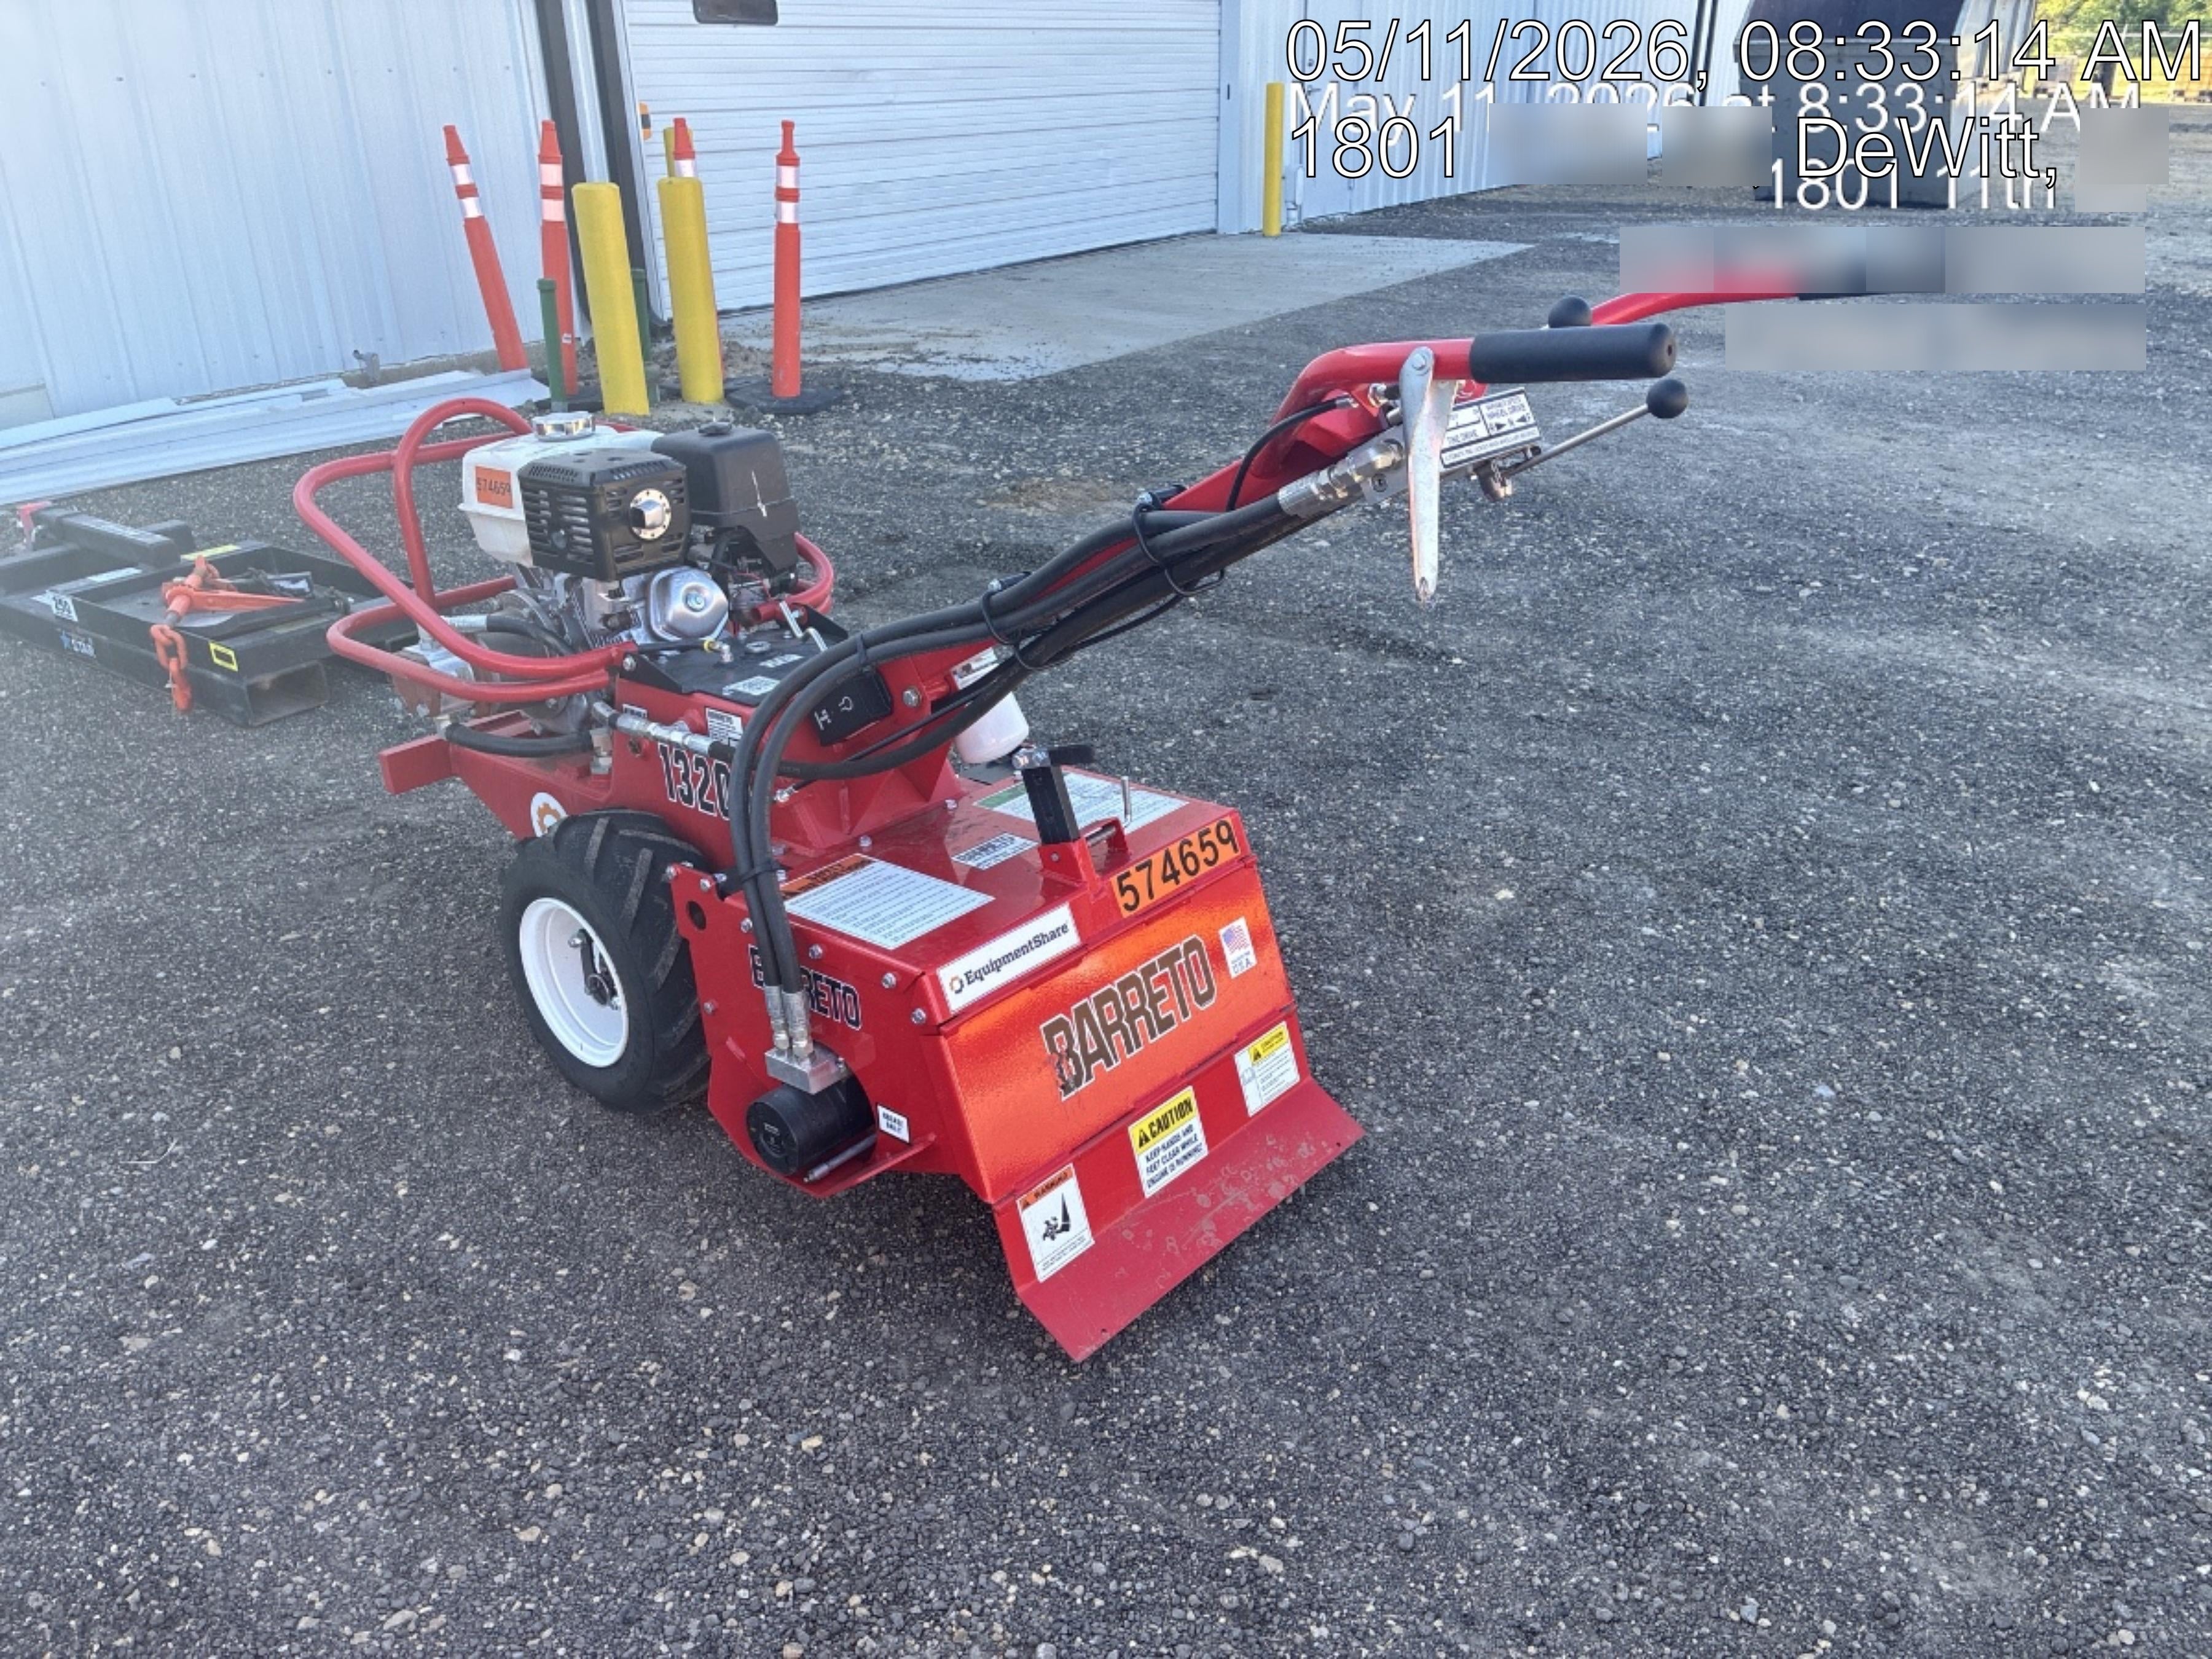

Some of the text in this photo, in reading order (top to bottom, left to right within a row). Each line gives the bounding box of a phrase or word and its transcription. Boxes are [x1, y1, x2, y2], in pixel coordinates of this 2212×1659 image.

[1116, 820, 1239, 911] 574659
[748, 943, 862, 1031] BRETO
[963, 922, 1070, 986] EquipmentShare
[1039, 934, 1217, 1102] BARRETO
[1148, 1096, 1193, 1138] CAUTION
